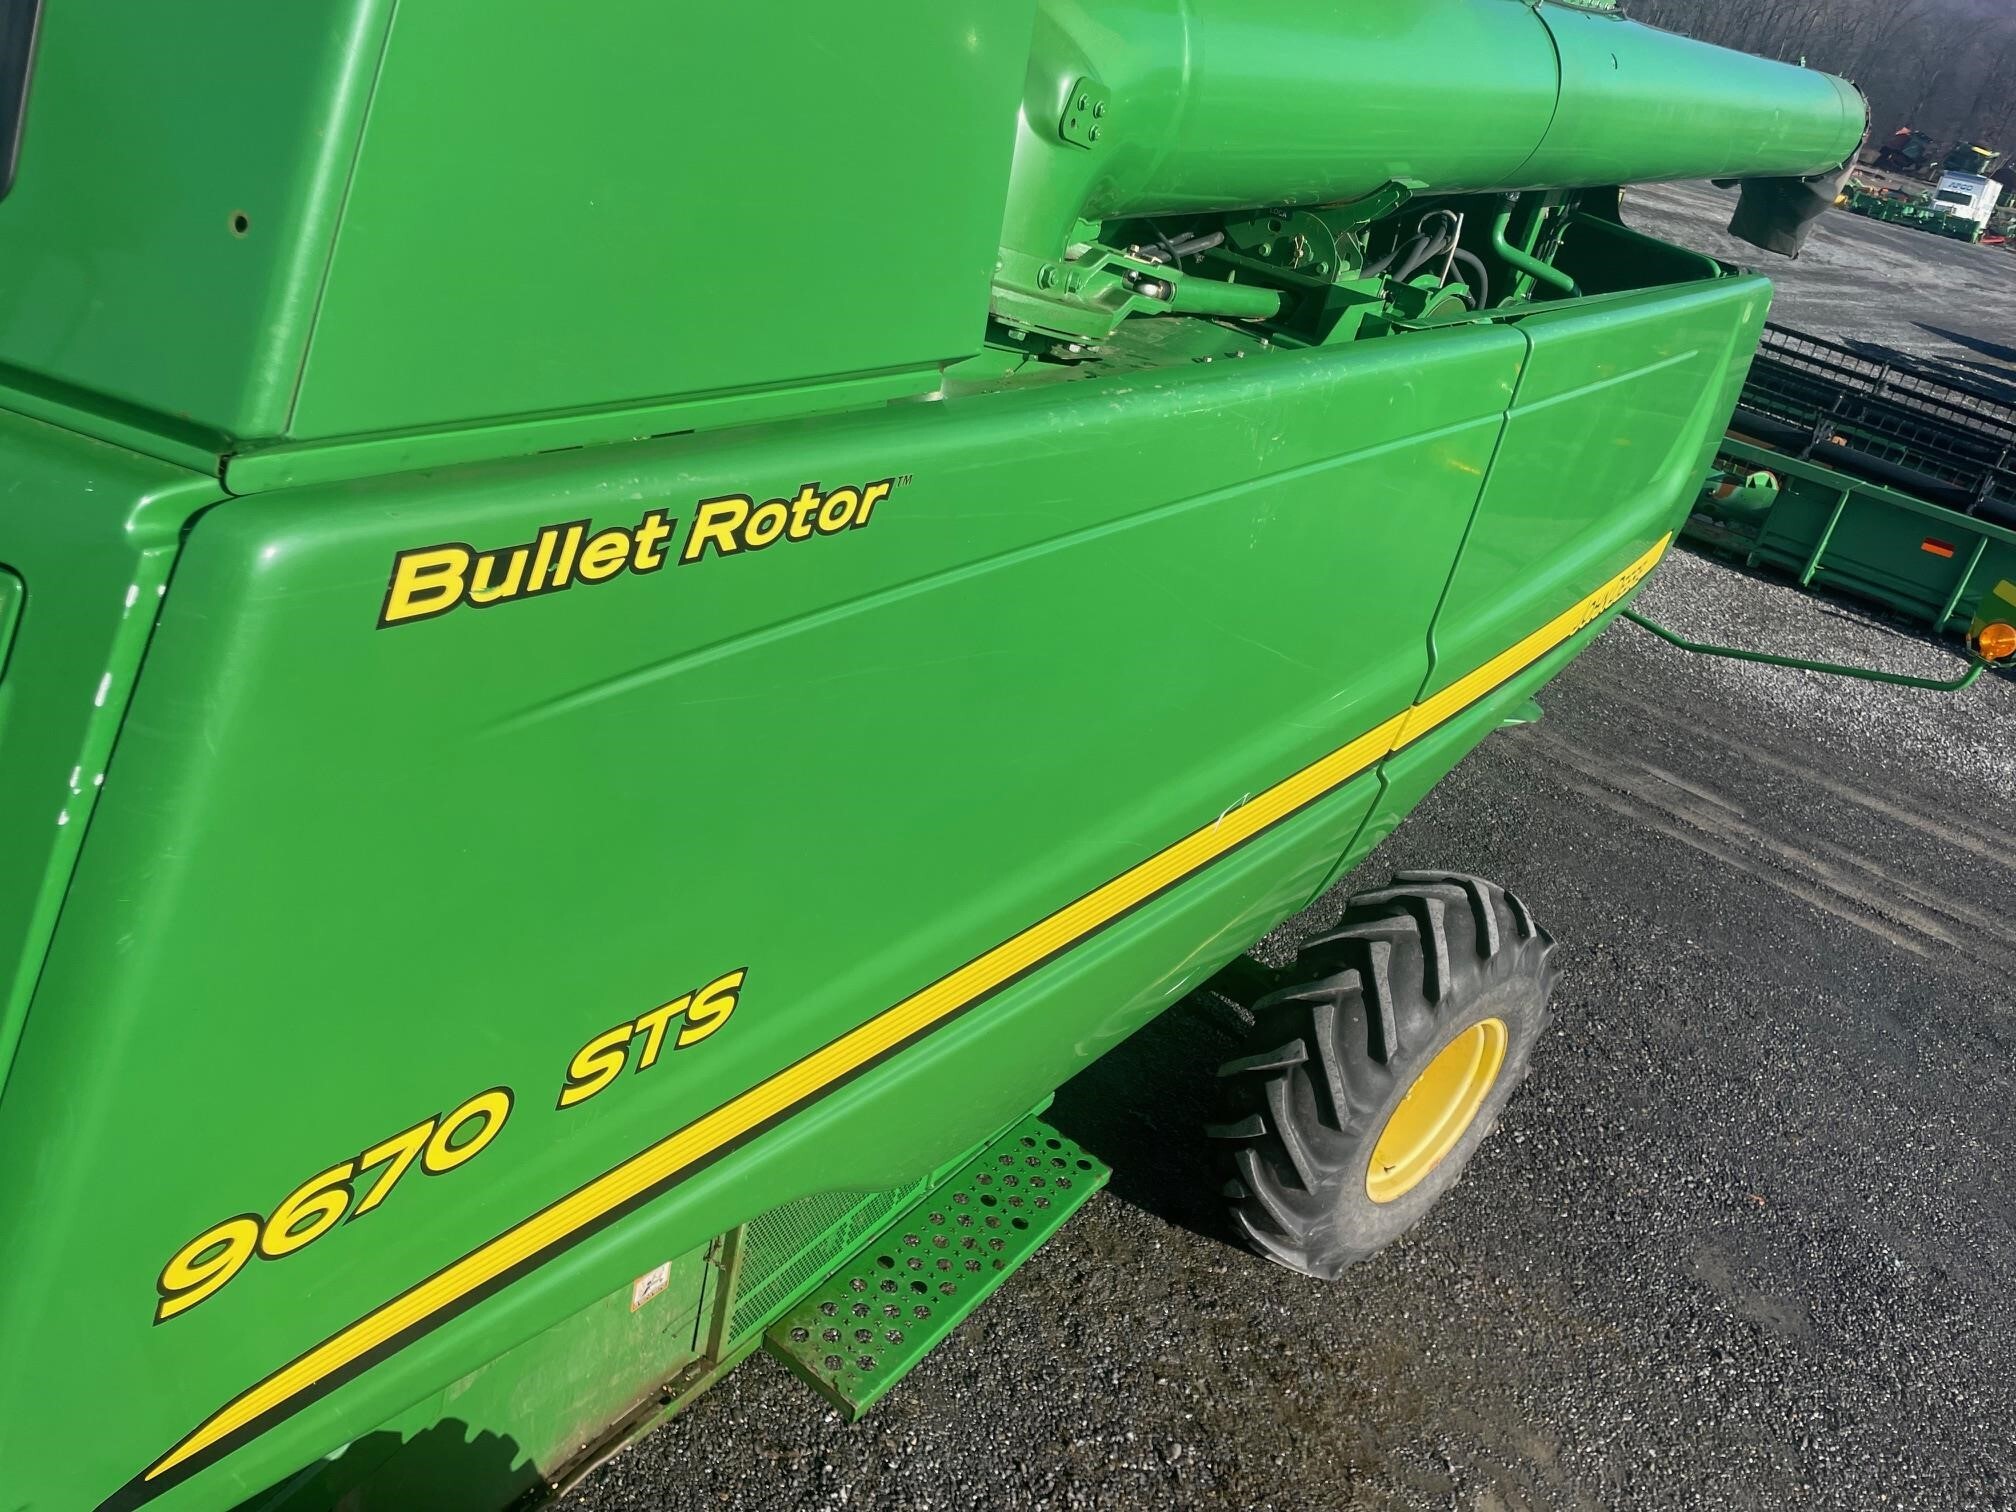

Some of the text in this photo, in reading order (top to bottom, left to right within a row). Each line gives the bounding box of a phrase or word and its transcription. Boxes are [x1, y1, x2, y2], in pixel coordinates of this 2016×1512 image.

[377, 508, 678, 629] Bullet
[678, 477, 895, 565] Rotor
[153, 967, 748, 1326] 9670 STS
